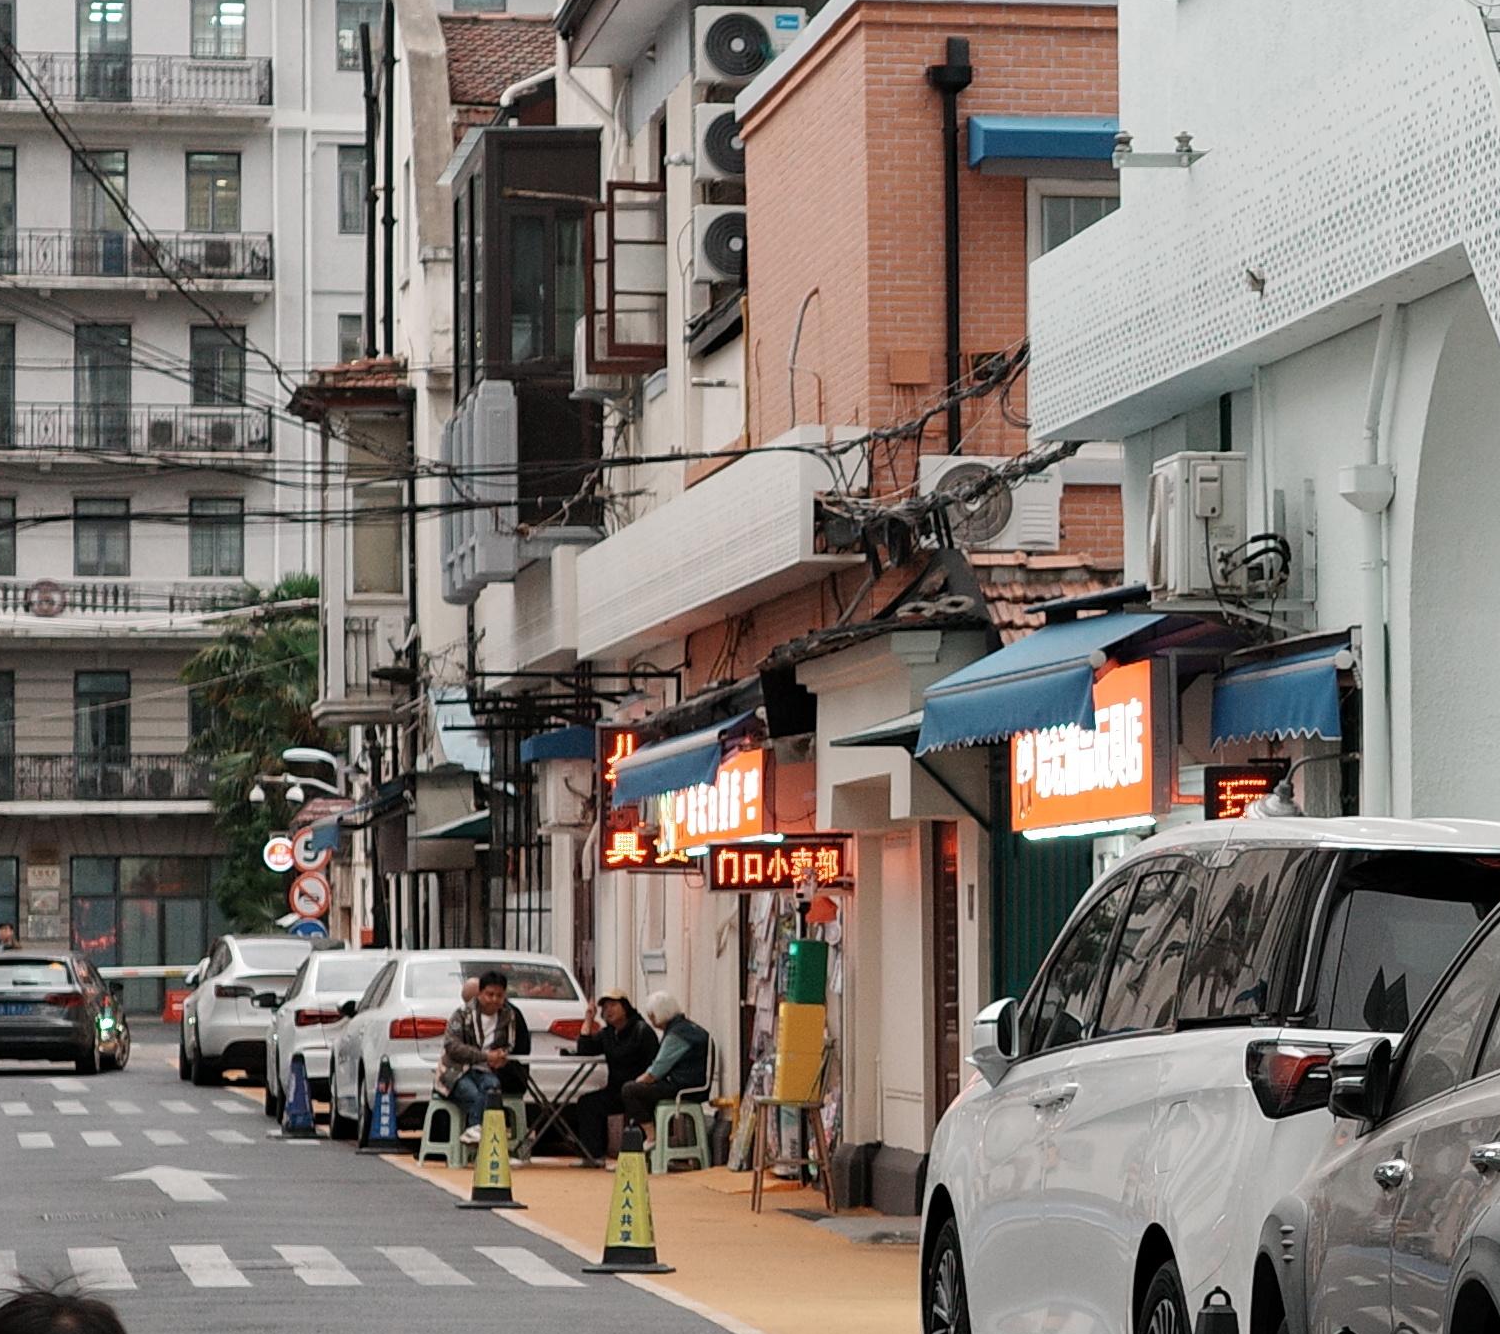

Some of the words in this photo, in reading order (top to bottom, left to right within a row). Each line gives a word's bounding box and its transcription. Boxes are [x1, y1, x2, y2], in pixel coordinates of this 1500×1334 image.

[717, 847, 839, 884] 门口小卖部
